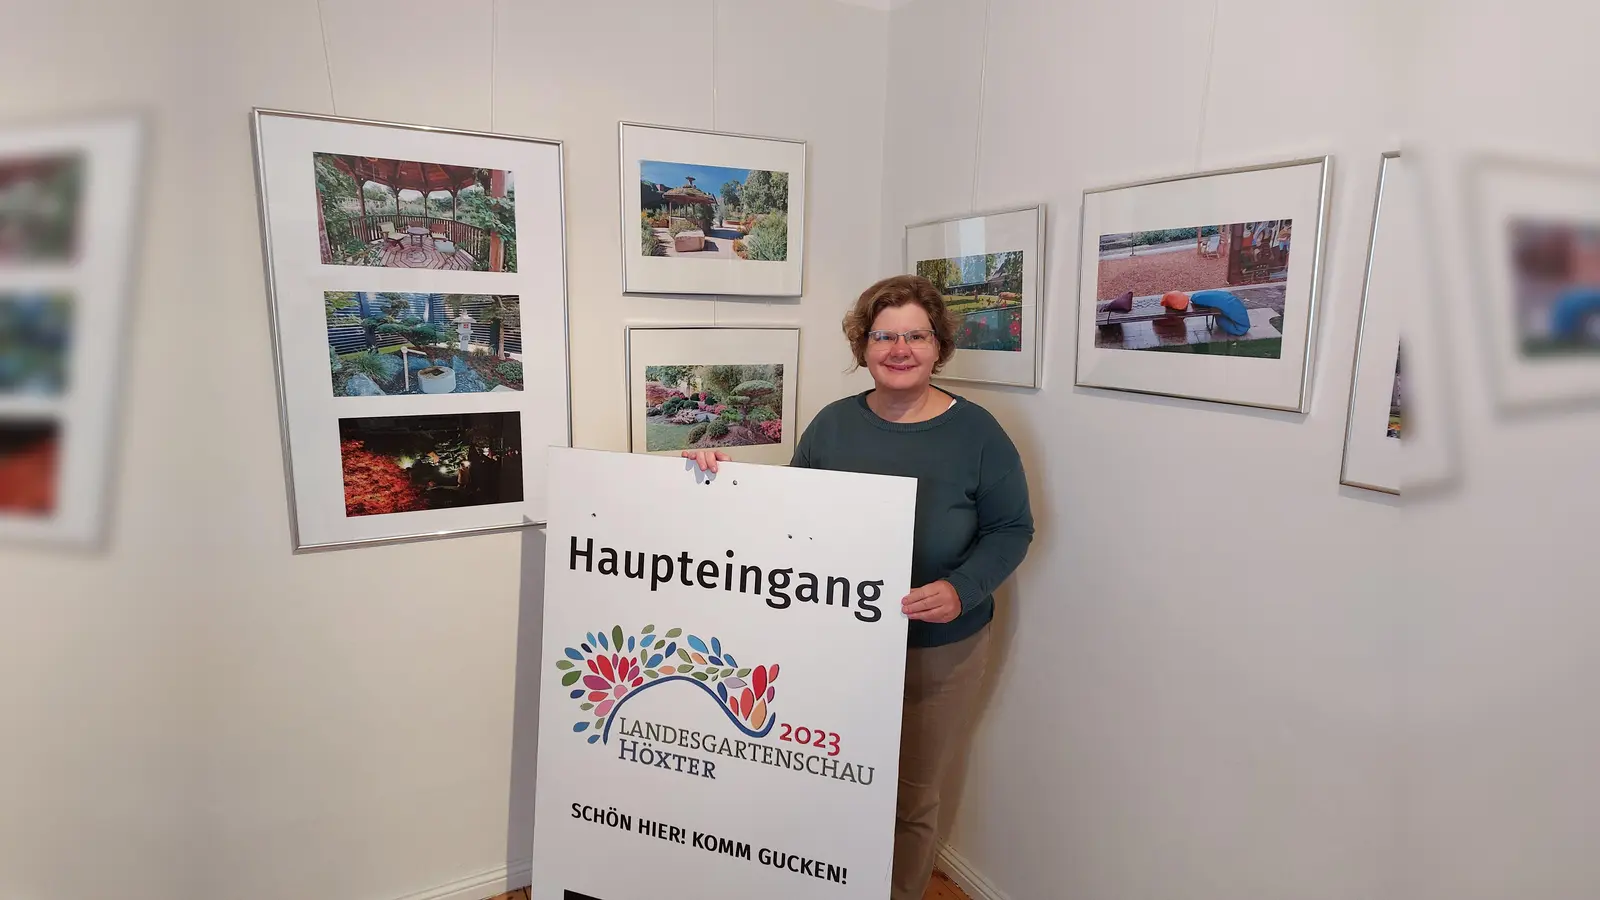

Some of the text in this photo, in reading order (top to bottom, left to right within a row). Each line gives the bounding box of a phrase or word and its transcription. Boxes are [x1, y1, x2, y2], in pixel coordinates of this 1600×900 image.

[569, 535, 884, 622] Haupteingang
[618, 739, 716, 779] HÖXTER
[619, 717, 875, 786] LANDESGARTENSCHAU
[779, 723, 841, 756] 2023
[571, 802, 848, 885] SCHÖN HIER! KOMM GUCKEN!
